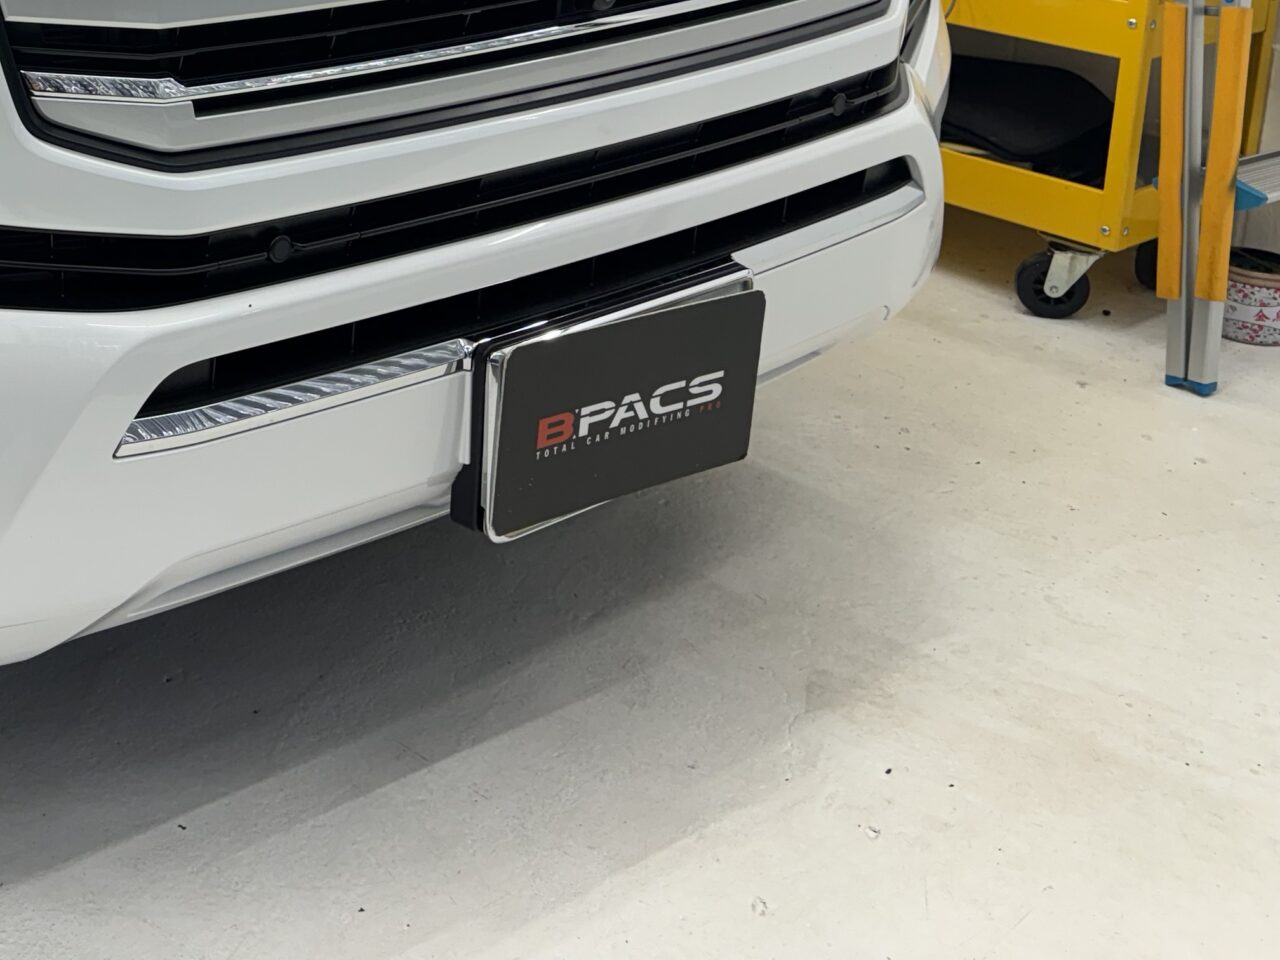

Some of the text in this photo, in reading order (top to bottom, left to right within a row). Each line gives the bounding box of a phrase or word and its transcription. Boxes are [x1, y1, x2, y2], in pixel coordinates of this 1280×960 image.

[535, 442, 577, 461] TOTAL
[586, 431, 611, 446] CAR
[619, 407, 691, 436] MODIFYING
[536, 369, 725, 450] BPACS
